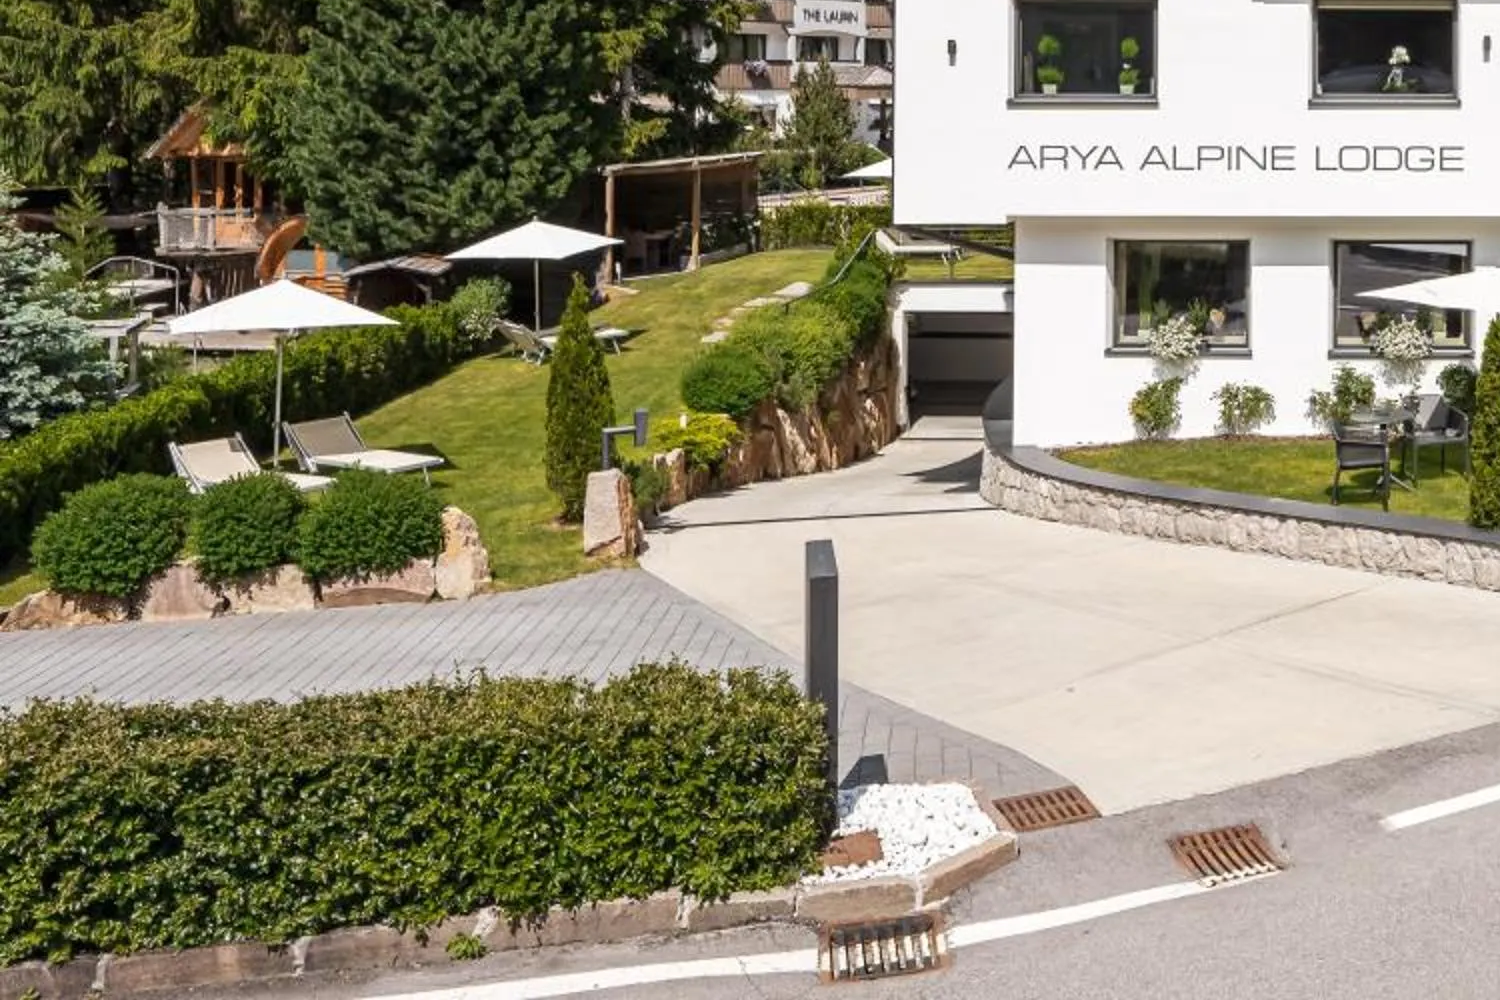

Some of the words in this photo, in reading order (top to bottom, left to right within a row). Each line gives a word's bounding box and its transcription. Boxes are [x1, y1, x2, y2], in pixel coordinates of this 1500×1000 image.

[802, 8, 821, 23] THE
[1007, 144, 1125, 171] ARYA
[1139, 144, 1297, 172] ALPINE
[1315, 145, 1465, 173] LODGE
